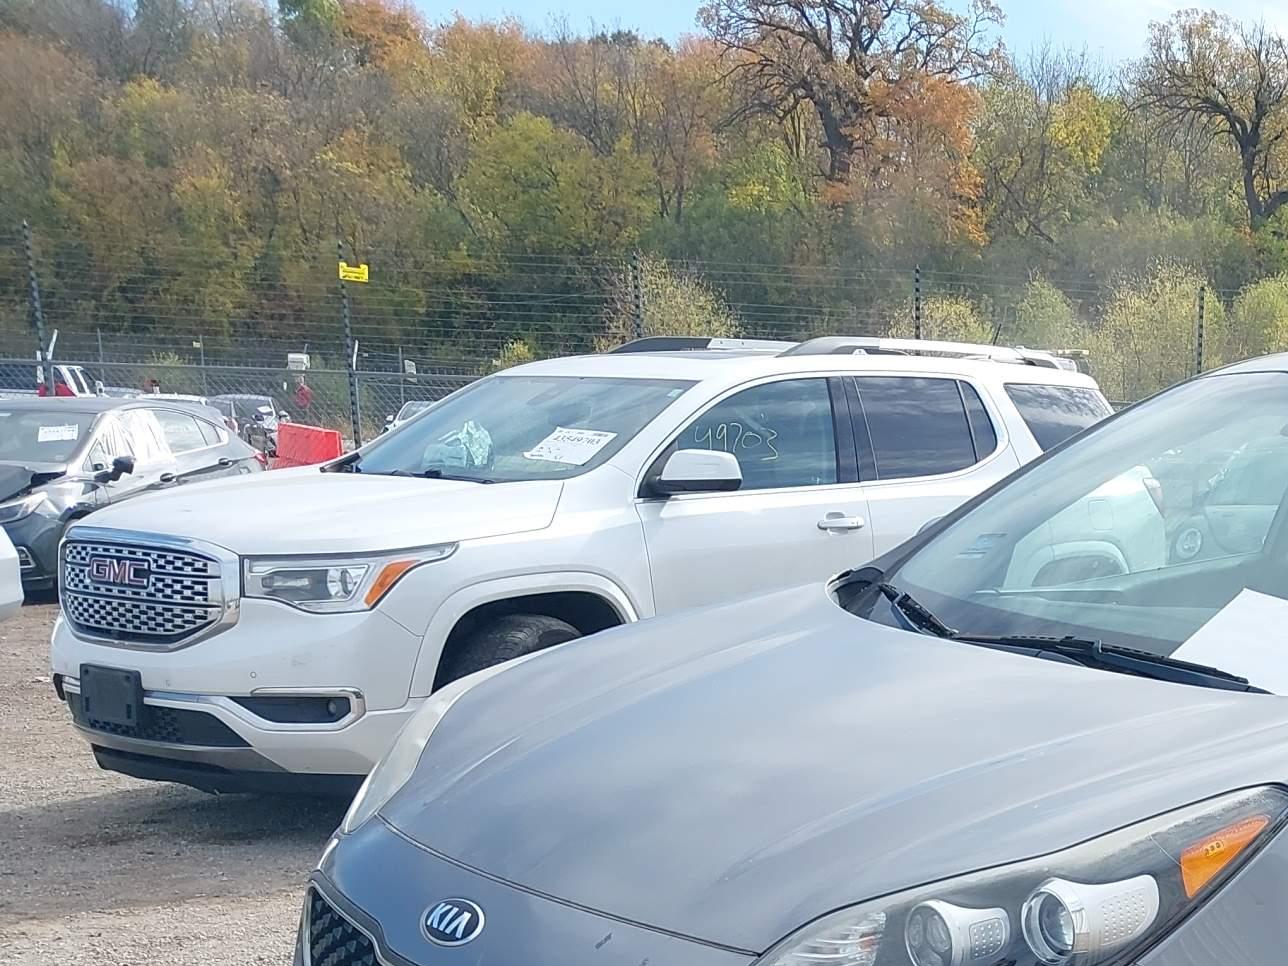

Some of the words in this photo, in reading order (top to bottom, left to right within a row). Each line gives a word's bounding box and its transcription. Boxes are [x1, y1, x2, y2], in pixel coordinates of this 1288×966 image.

[694, 422, 778, 461] 49703
[90, 556, 149, 586] GMC
[426, 902, 472, 939] KIA
